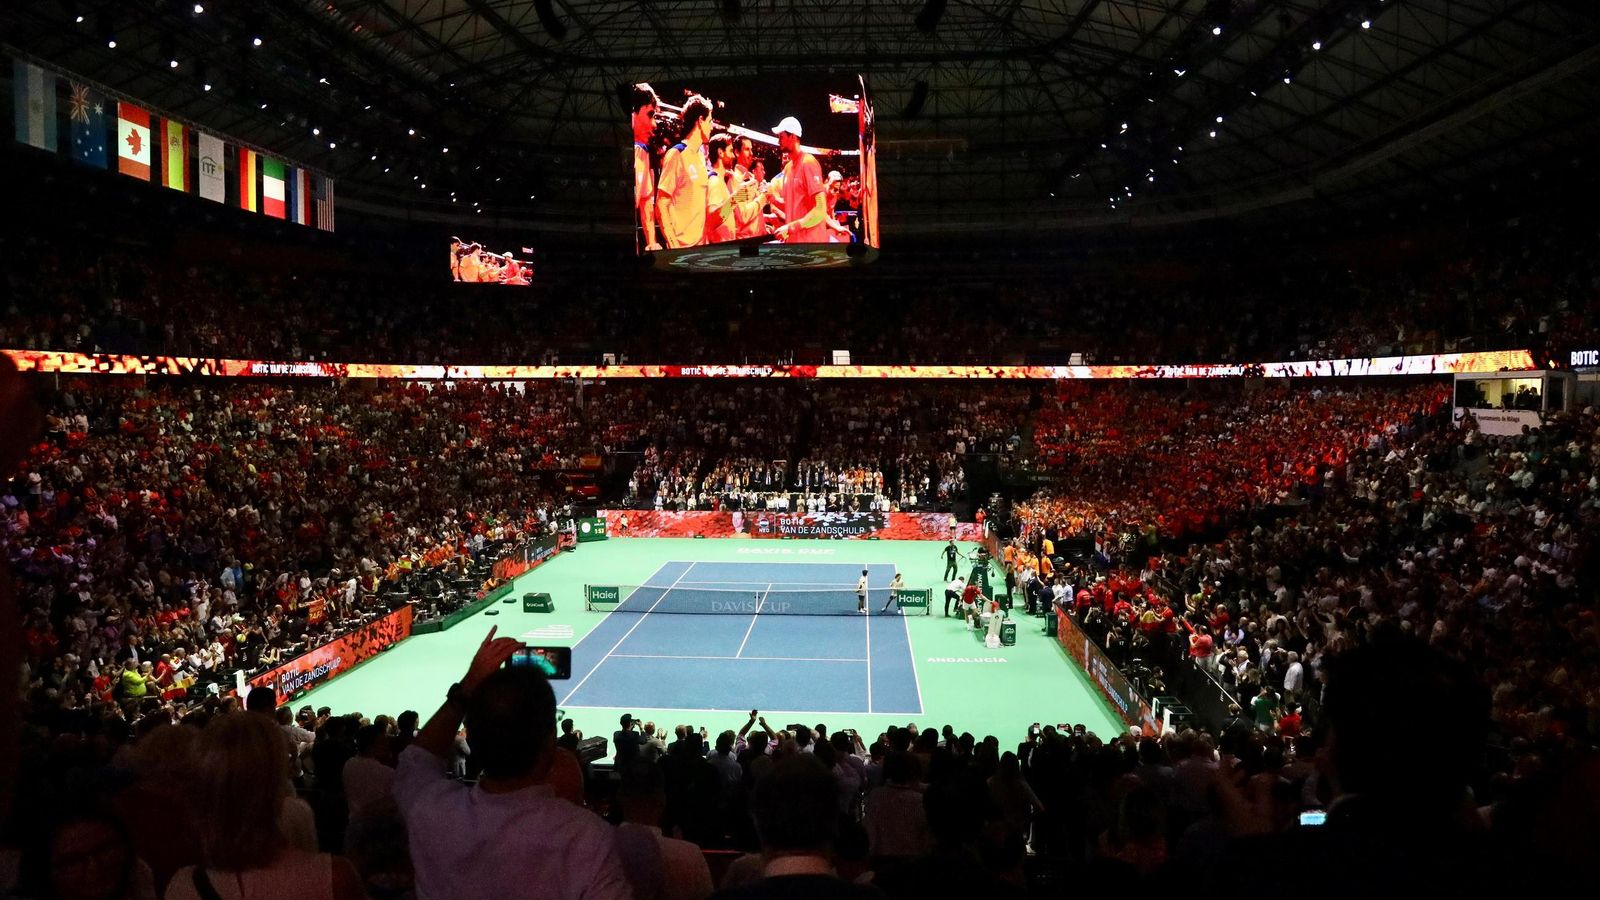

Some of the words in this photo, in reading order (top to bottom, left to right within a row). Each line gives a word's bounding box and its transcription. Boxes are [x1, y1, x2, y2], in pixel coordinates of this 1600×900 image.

[203, 161, 216, 175] ITF
[1570, 350, 1599, 366] BOTIC
[681, 367, 701, 375] BOTIC
[781, 526, 796, 534] VAN
[799, 526, 809, 534] DE
[811, 526, 865, 534] ZANDSCHULP
[592, 590, 617, 599] Haier
[898, 594, 925, 603] Haier
[711, 601, 754, 612] DAVIS
[761, 601, 791, 612] CUP
[282, 667, 299, 682] BOTIC
[282, 682, 295, 694] VAN
[295, 677, 304, 688] DE
[304, 657, 341, 682] ZANDSCHULP
